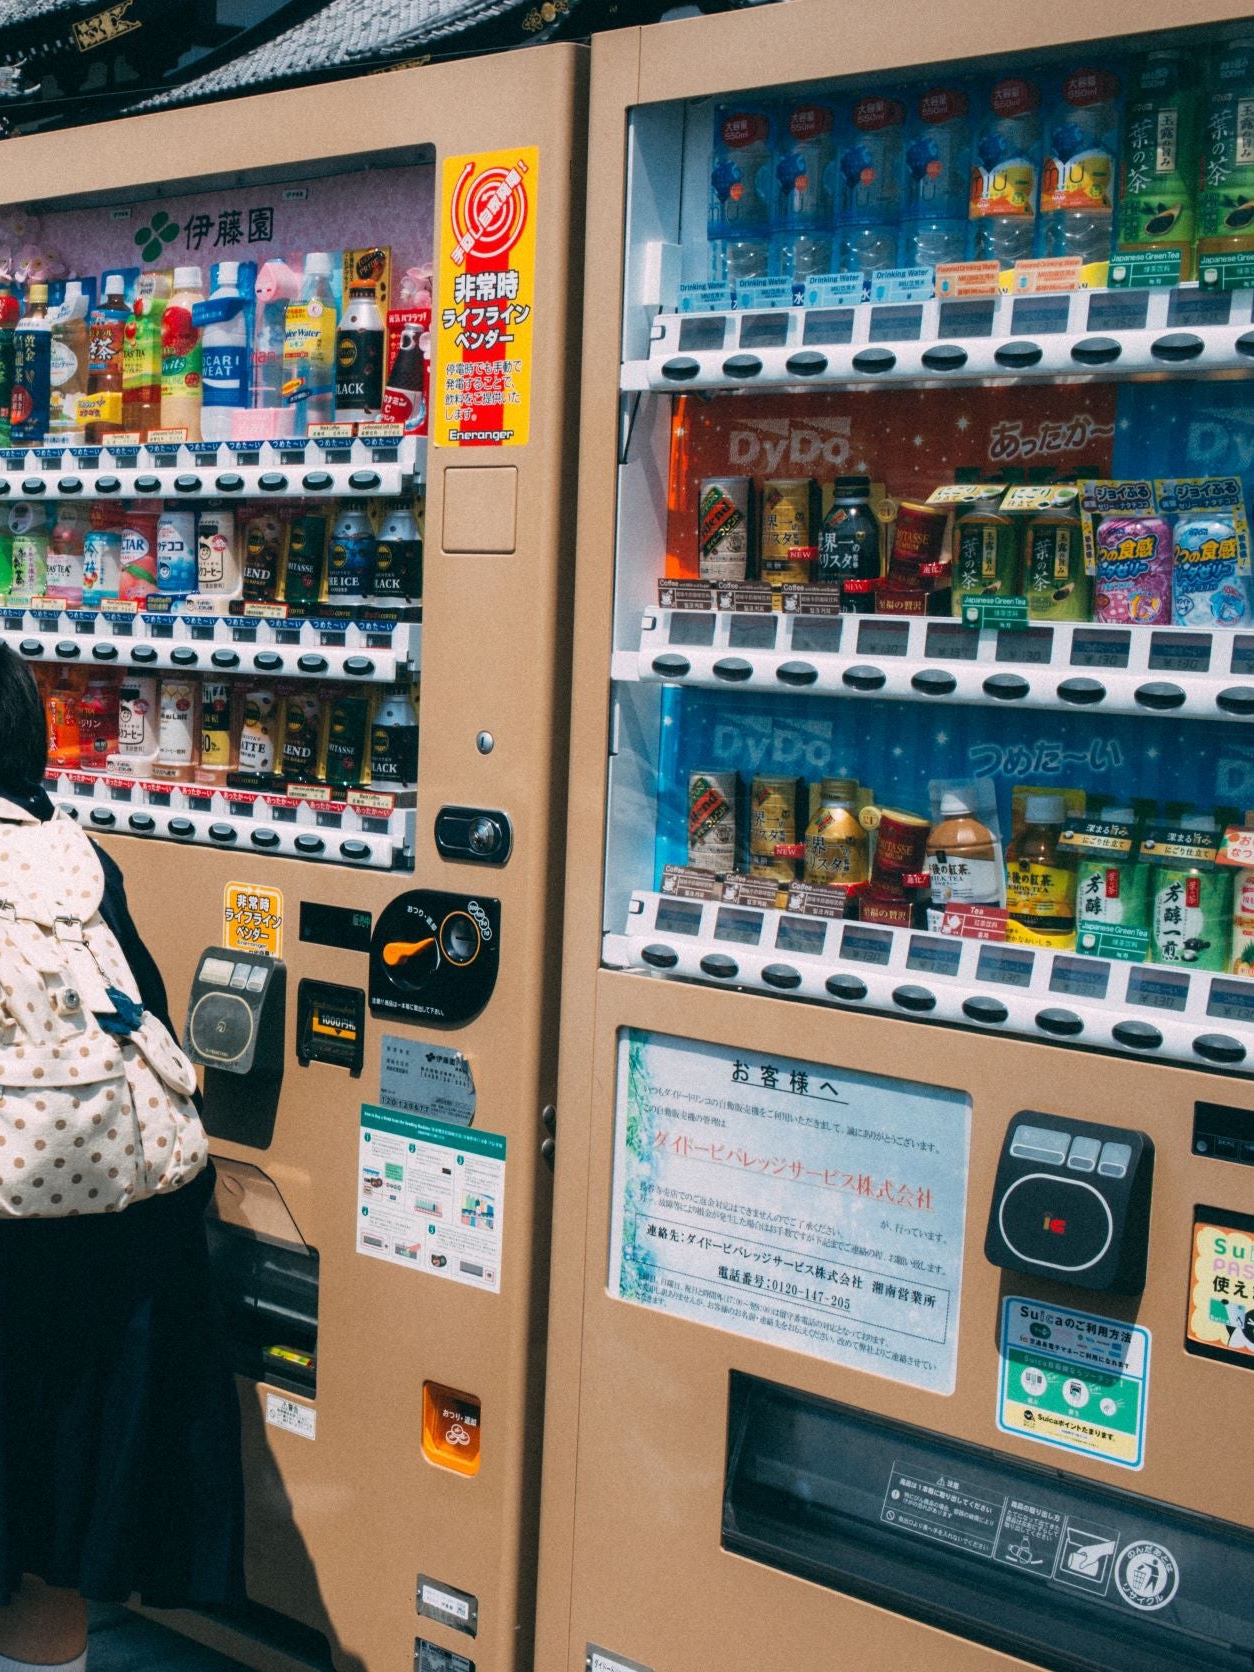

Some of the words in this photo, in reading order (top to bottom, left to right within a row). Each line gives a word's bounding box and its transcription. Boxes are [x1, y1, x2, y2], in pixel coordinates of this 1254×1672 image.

[857, 101, 885, 115] 大容量
[1208, 109, 1233, 187] 葉の茶
[1130, 119, 1153, 195] 葉の茶
[184, 206, 275, 249] 伊藤園
[1111, 253, 1144, 263] Japanese
[1146, 252, 1166, 261] Green
[1167, 251, 1180, 260] Tea
[1200, 255, 1236, 265] Japanese
[809, 275, 836, 284] Drinking
[838, 274, 859, 282] Water
[876, 271, 906, 279] Drinking
[908, 269, 929, 277] Water
[454, 269, 520, 304] 非常時
[679, 283, 706, 291] Drinking
[708, 281, 726, 289] Water
[739, 279, 766, 287] Drinking
[768, 278, 787, 286] Water
[442, 303, 531, 330] ライフライン
[298, 329, 322, 338] Water
[454, 329, 514, 350] ベンダー
[445, 360, 522, 376] 停電時でも手動で
[445, 375, 515, 392] 発電することで、
[445, 390, 521, 407] 飲料をご提供いた
[384, 405, 391, 414] C
[445, 407, 478, 422] します。
[449, 428, 514, 442] Eneranger
[729, 425, 851, 473] DyDo
[1096, 486, 1150, 500] ジョイふる
[1176, 481, 1239, 498] ジョイふる
[789, 550, 812, 559] NEW
[961, 537, 979, 590] 葉の茶
[1033, 539, 1052, 592] 葉の茶
[341, 576, 360, 587] ICE
[659, 579, 679, 588] Coffee
[718, 581, 738, 590] Coffee
[783, 583, 805, 592] Coffee
[963, 596, 994, 605] Japanese
[995, 597, 1014, 606] Green
[1015, 598, 1026, 606] Tea
[713, 719, 833, 768] DyDo
[967, 739, 1123, 778] つめた～い
[1085, 823, 1129, 836] 深まる旨み
[1082, 837, 1125, 849] にごり仕立て
[1167, 832, 1213, 845] 深まる旨み
[775, 847, 796, 856] NEW
[1164, 845, 1210, 858] にごり仕立て
[664, 866, 686, 875] Coffee
[726, 874, 747, 884] Coffee
[791, 882, 813, 892] Coffee
[1085, 872, 1104, 915] 芳醇
[236, 893, 271, 912] 非常時
[970, 906, 984, 915] Tea
[224, 907, 283, 929] ライフライン
[1162, 881, 1184, 961] 芳醇一煎
[236, 926, 270, 942] ベンダー
[1081, 921, 1114, 933] Japanese
[1115, 925, 1135, 934] Green
[1136, 927, 1148, 937] Tea
[321, 1014, 356, 1030] 1000円札
[731, 1058, 839, 1100] お客様へ
[643, 1103, 726, 1128] この自動販売機の管理は
[654, 1129, 935, 1211] ダイドービバレッジサービス株式会社
[880, 1220, 948, 1245] が、行っています。
[646, 1223, 863, 1289] 連絡先：ダイドービバレッジサービス株式会社
[871, 1280, 936, 1309] 湘南営業所
[717, 1264, 850, 1311] 電話番号：0120-147-205
[1020, 1305, 1132, 1344] Suicaのご利用方法
[1037, 1412, 1115, 1442] Suicaポイントたまります。
[1010, 1500, 1060, 1522] 商品の取り出し方
[1003, 1521, 1052, 1542] 取り出してください
[1127, 1545, 1174, 1574] のんだあとは
[1122, 1582, 1164, 1606] リサイクル
